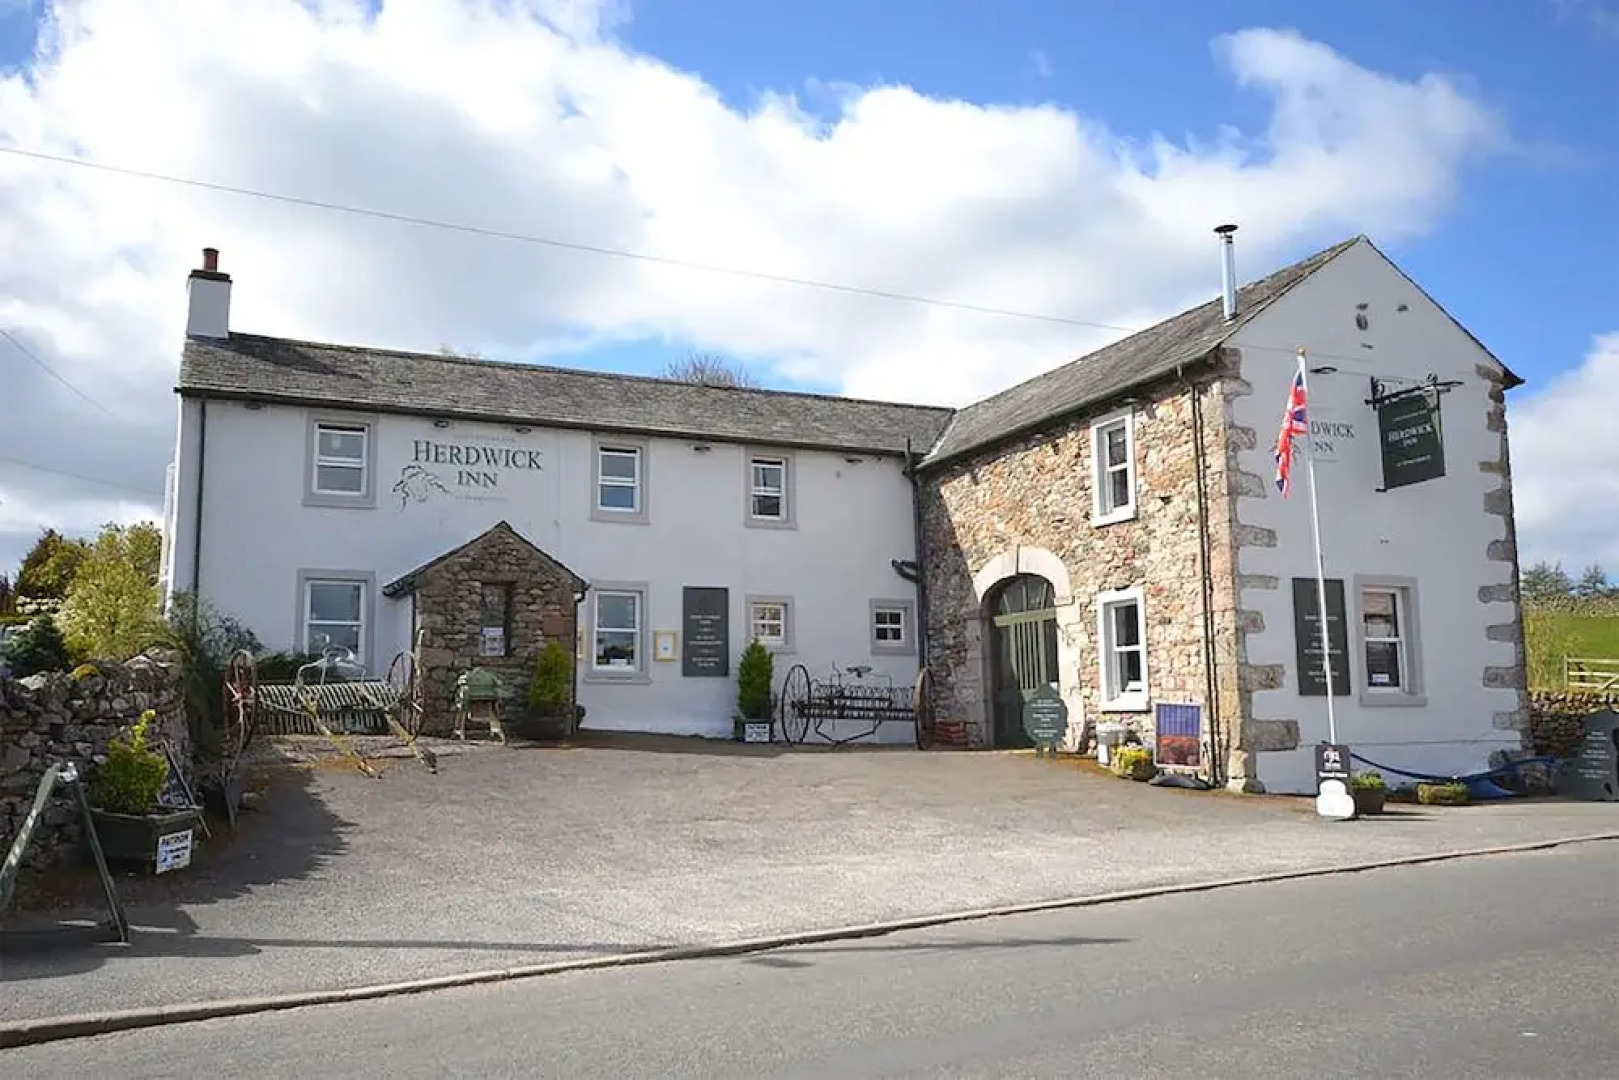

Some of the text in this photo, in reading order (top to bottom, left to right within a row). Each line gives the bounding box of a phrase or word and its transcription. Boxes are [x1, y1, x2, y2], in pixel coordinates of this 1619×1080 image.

[1311, 421, 1355, 438] DWICK
[413, 440, 544, 470] HERDWICK
[1314, 440, 1334, 453] NN
[457, 470, 498, 487] INN
